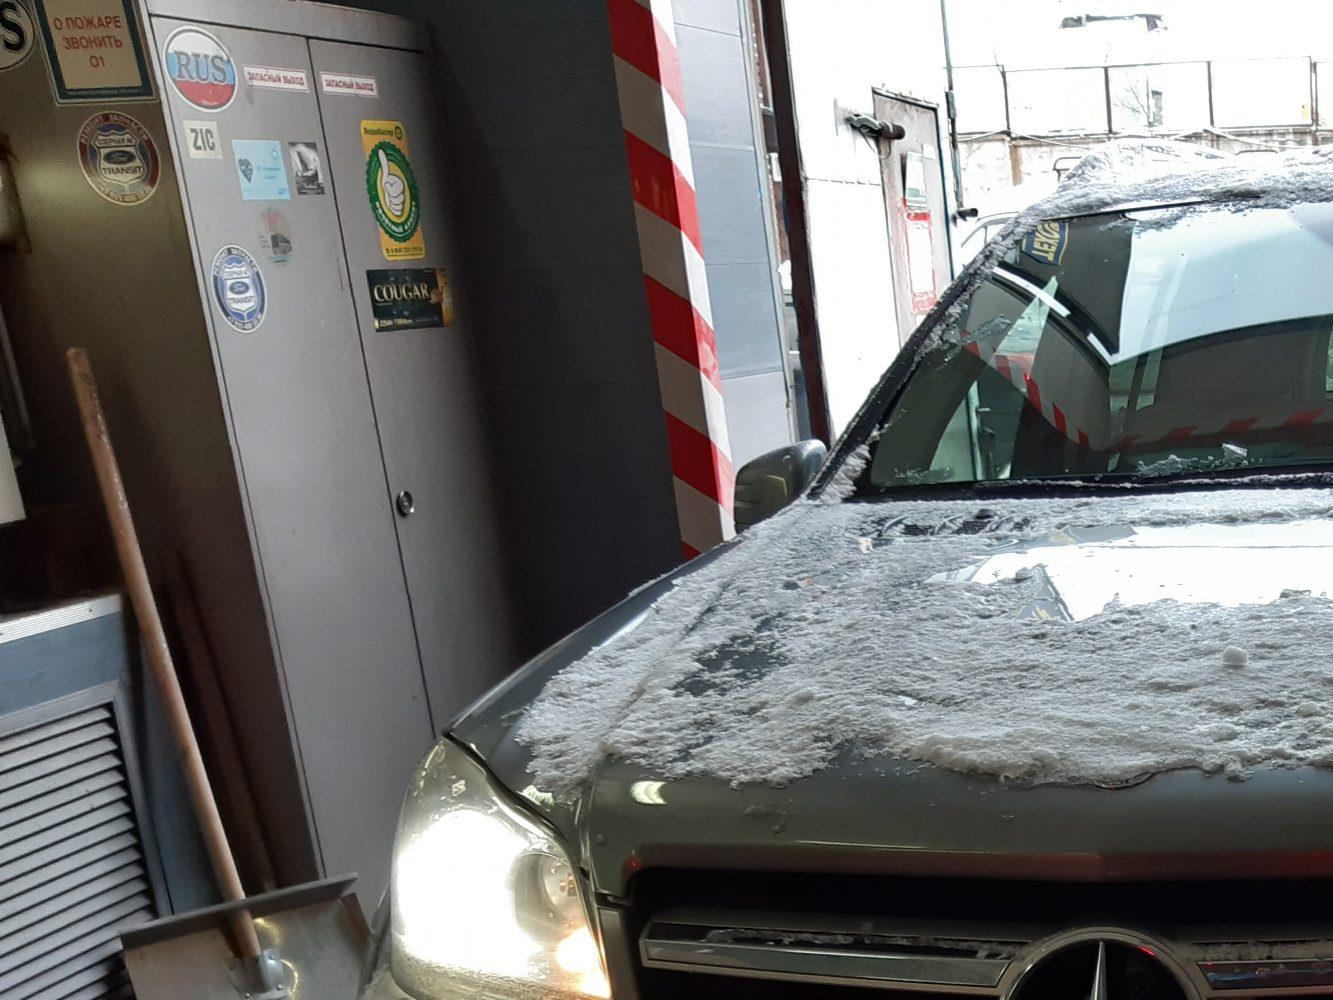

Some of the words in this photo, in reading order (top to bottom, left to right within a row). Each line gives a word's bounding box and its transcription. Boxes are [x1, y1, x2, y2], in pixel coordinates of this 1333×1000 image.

[53, 18, 62, 30] О
[66, 16, 122, 30] ПОЖАРЕ
[63, 36, 123, 49] ЗВОНИТЬ
[90, 56, 105, 68] 01
[174, 50, 228, 83] RUS
[247, 72, 282, 83] ЗАПАСНЫЙ
[190, 128, 216, 151] ZIC
[374, 283, 430, 302] COUGAR
